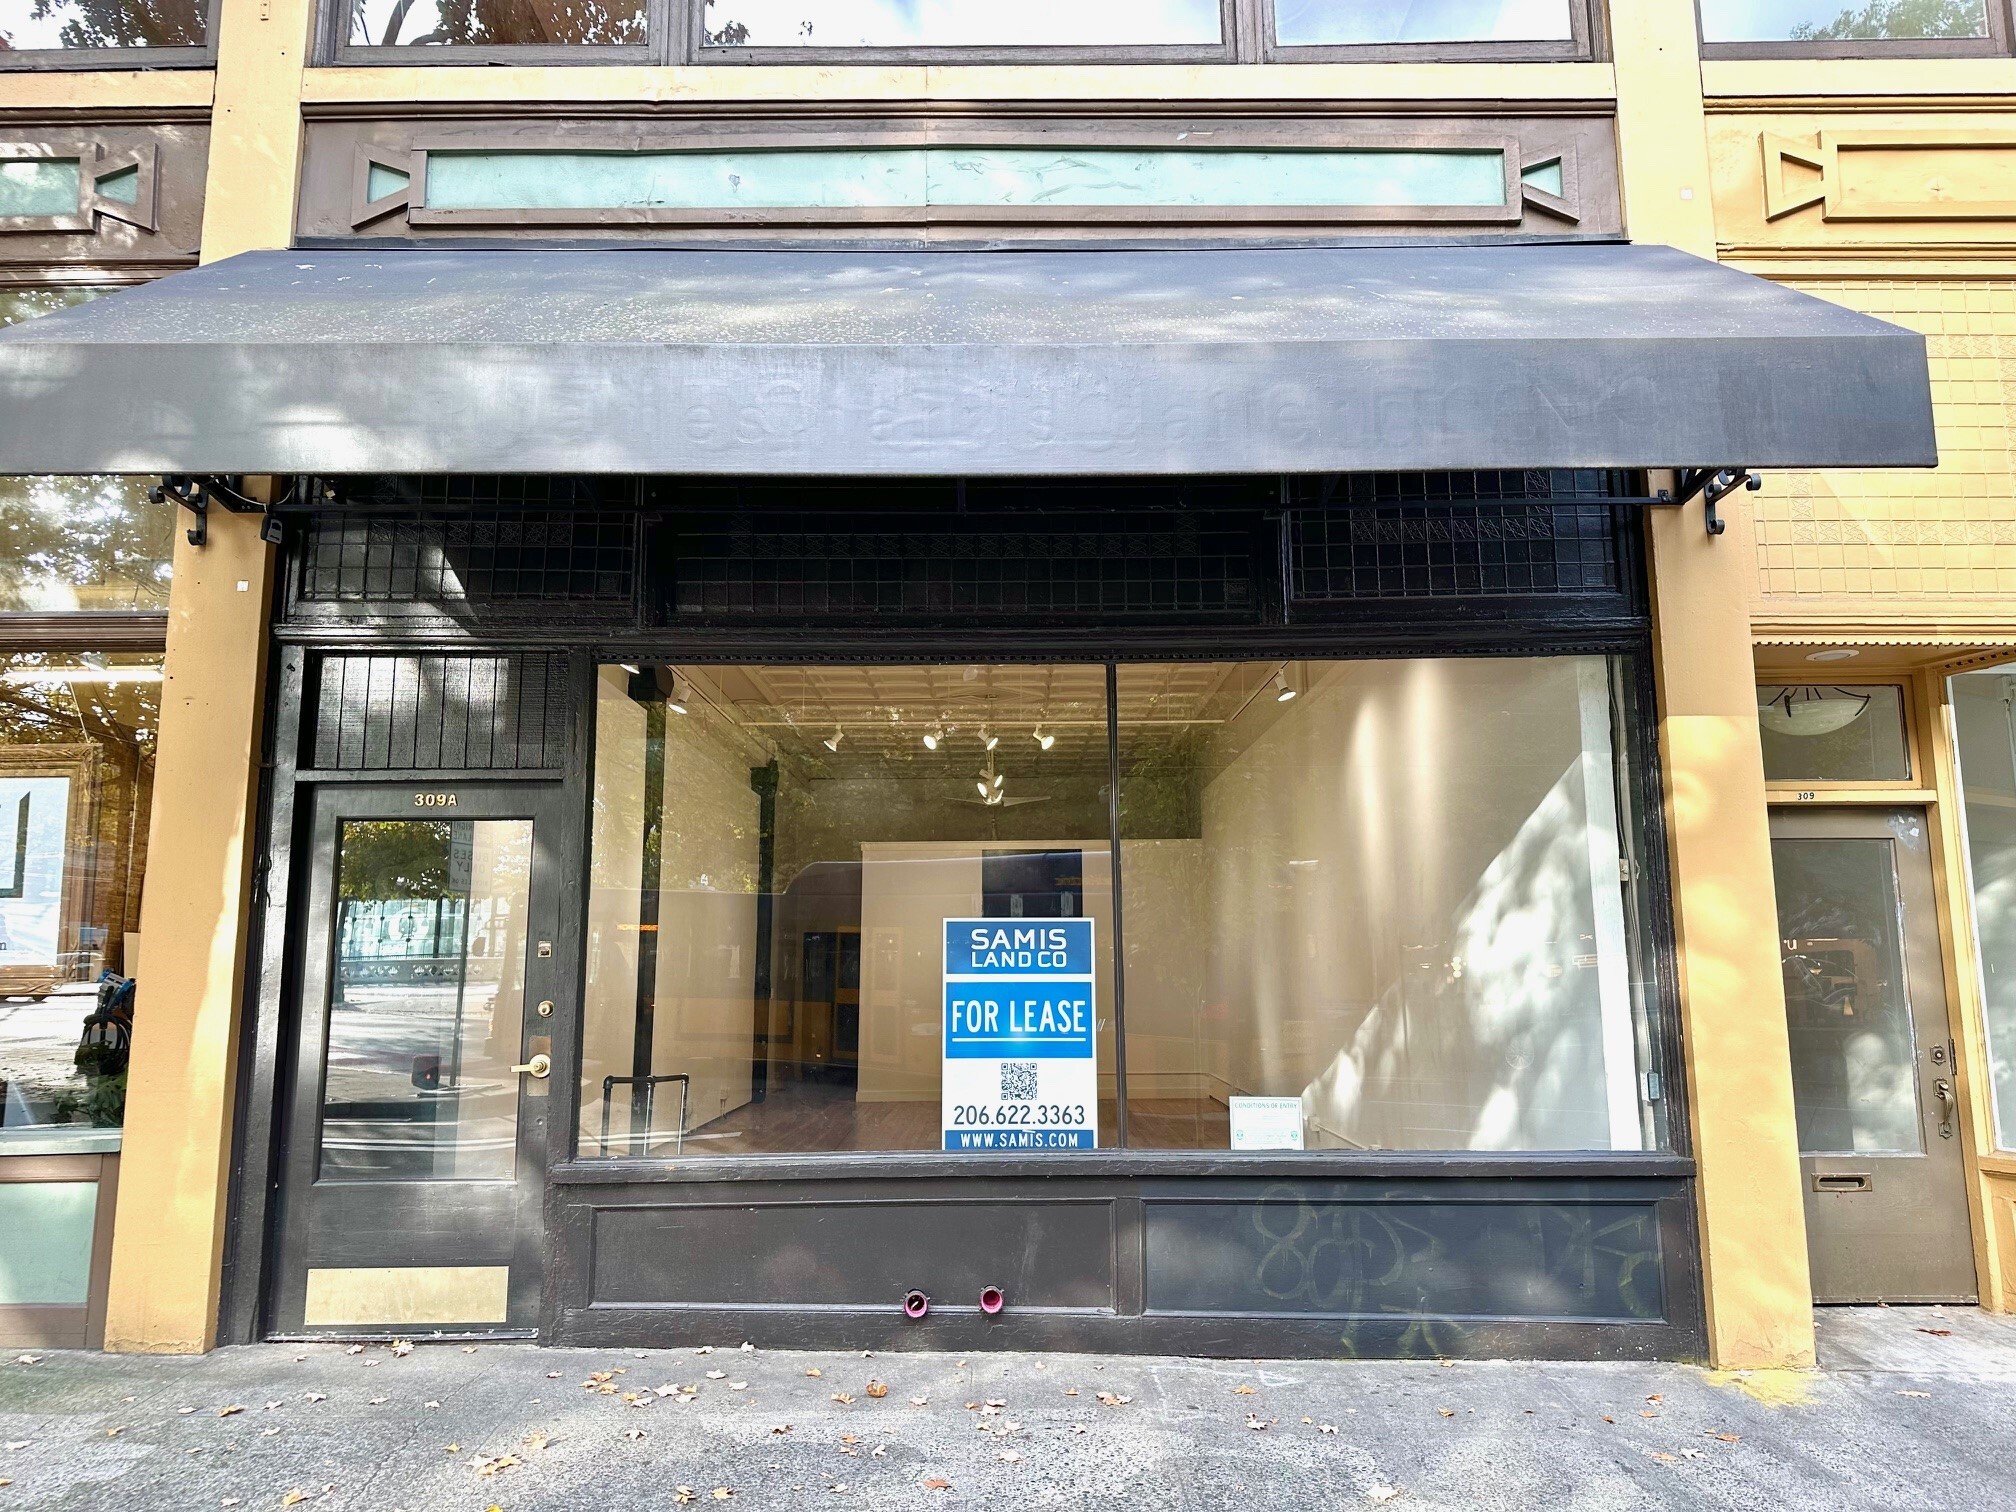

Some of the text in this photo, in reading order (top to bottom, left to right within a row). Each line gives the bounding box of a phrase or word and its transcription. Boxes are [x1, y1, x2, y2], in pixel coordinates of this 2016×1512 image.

[414, 793, 458, 807] 309A
[1797, 792, 1815, 800] 309
[971, 928, 1067, 949] SAMIS
[971, 951, 1067, 968] LAND CO
[952, 1000, 1087, 1033] FOR LEASE
[953, 1105, 1085, 1125] 206.622.3363
[960, 1133, 1078, 1148] WWW.SAMIS.COM
